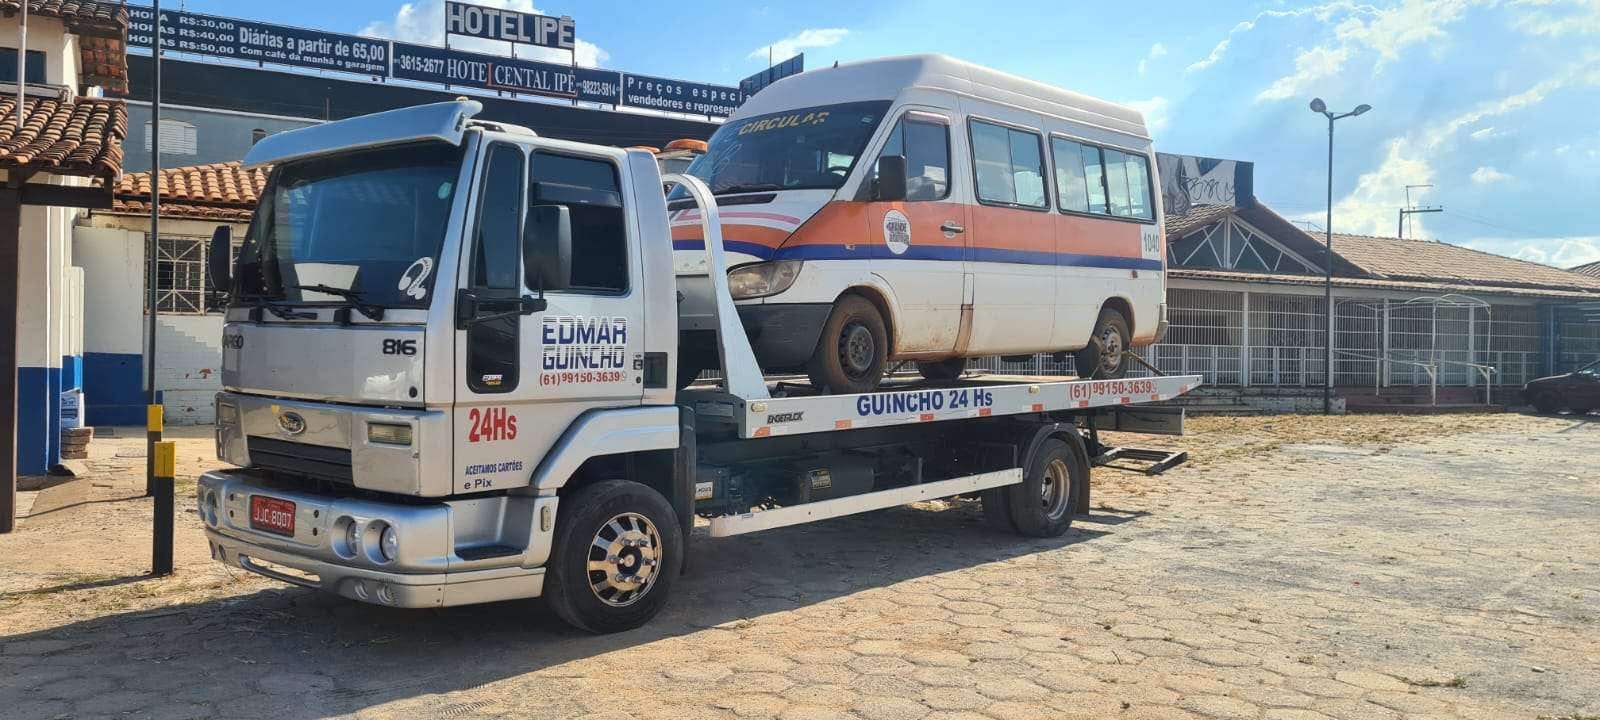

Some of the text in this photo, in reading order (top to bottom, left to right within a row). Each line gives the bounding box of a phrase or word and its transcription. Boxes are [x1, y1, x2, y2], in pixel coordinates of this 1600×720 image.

[447, 2, 575, 49] HOTEL IPÊ
[239, 26, 384, 62] Diárias a partir de 65,00
[240, 46, 263, 56] Com
[289, 52, 301, 61] da
[303, 55, 334, 65] manhã
[345, 60, 384, 72] garagem
[400, 54, 444, 74] 3615-2677
[447, 58, 576, 94] HOTEL CENTAL IPÊ
[627, 76, 682, 95] Preços
[628, 93, 683, 111] vendedores
[686, 101, 692, 110] e
[1143, 232, 1160, 253] 1040
[542, 316, 627, 345] EDMAR
[382, 338, 417, 356] 816
[543, 346, 625, 370] GUINCHO
[856, 387, 994, 417] GUINCHO 24 Hs
[468, 407, 517, 442] 24Hs
[465, 459, 523, 476] ACEITAMOS CARTÕES
[464, 477, 492, 490] e Pix
[271, 510, 292, 528] 8007
